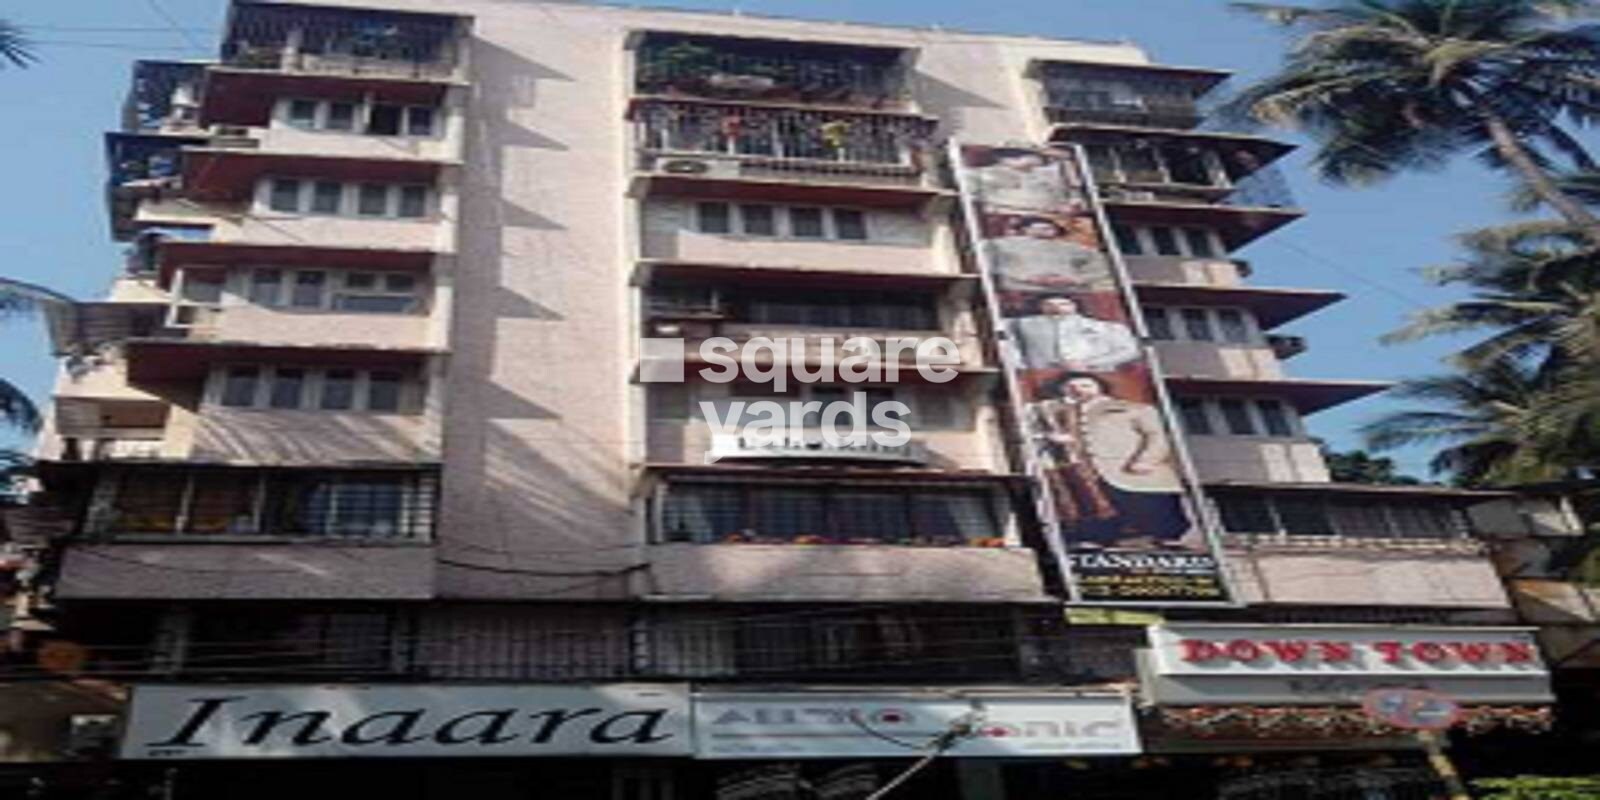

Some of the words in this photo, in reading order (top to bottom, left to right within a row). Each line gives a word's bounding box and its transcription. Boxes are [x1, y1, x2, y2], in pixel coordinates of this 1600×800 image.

[1179, 638, 1355, 664] DOWN
[1374, 641, 1536, 664] TOWN
[147, 695, 674, 748] Inaara
